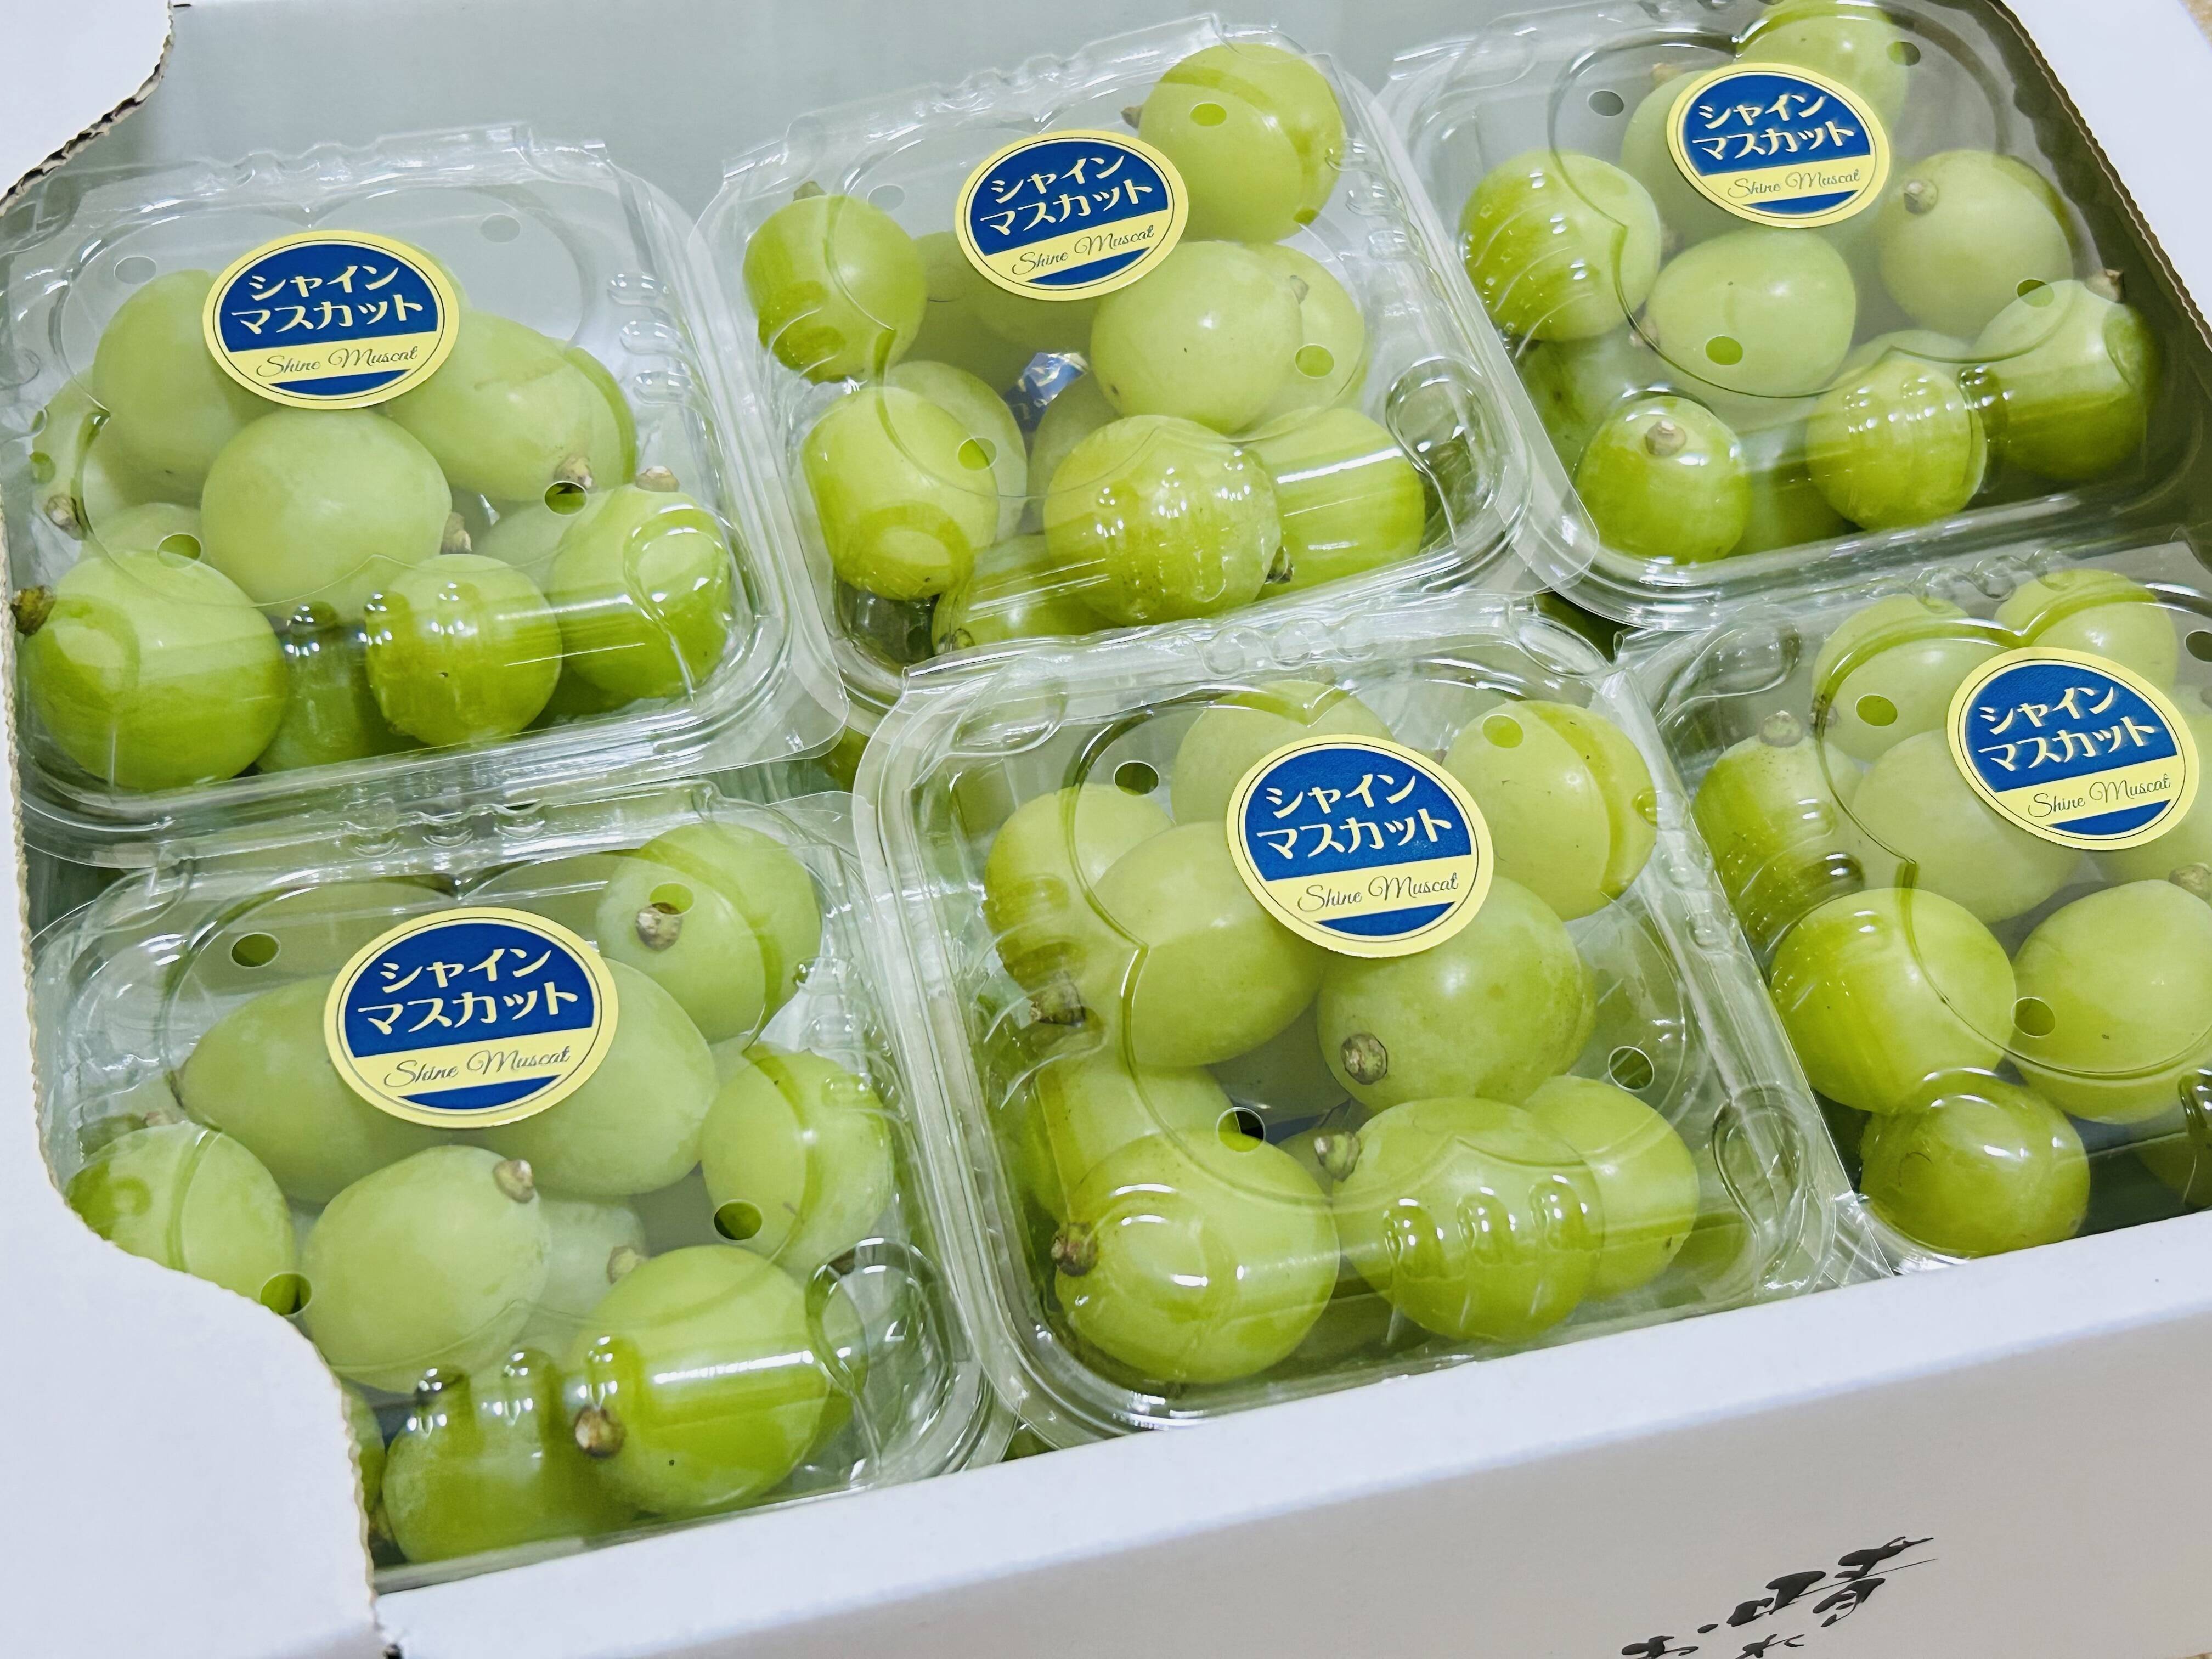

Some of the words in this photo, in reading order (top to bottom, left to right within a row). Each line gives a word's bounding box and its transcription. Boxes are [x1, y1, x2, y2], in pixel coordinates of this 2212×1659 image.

[1699, 94, 1825, 129] シャイン
[1692, 121, 1854, 160] マスカット
[991, 155, 1125, 203] シャイン
[1728, 178, 1780, 198] Shine
[1785, 168, 1860, 189] Muscat
[980, 179, 1152, 235] マスカット
[1012, 252, 1068, 275] Shine
[1074, 225, 1154, 255] Muscat
[249, 265, 399, 301] シャイン
[232, 294, 423, 334] マスカット
[256, 355, 320, 377] Shine
[328, 346, 418, 368] Muscat
[1979, 687, 2113, 735] シャイン
[1978, 716, 2154, 771] マスカット
[1266, 774, 1416, 818] シャイン
[2028, 793, 2085, 817] Shine
[2089, 774, 2171, 803] Muscat
[1256, 809, 1452, 859] マスカット
[1297, 885, 1362, 912] Shine
[1368, 873, 1459, 900] Muscat
[380, 948, 551, 993] シャイン
[358, 981, 578, 1035] マスカット
[384, 1060, 459, 1087] Shine
[466, 1046, 570, 1075] Muscat
